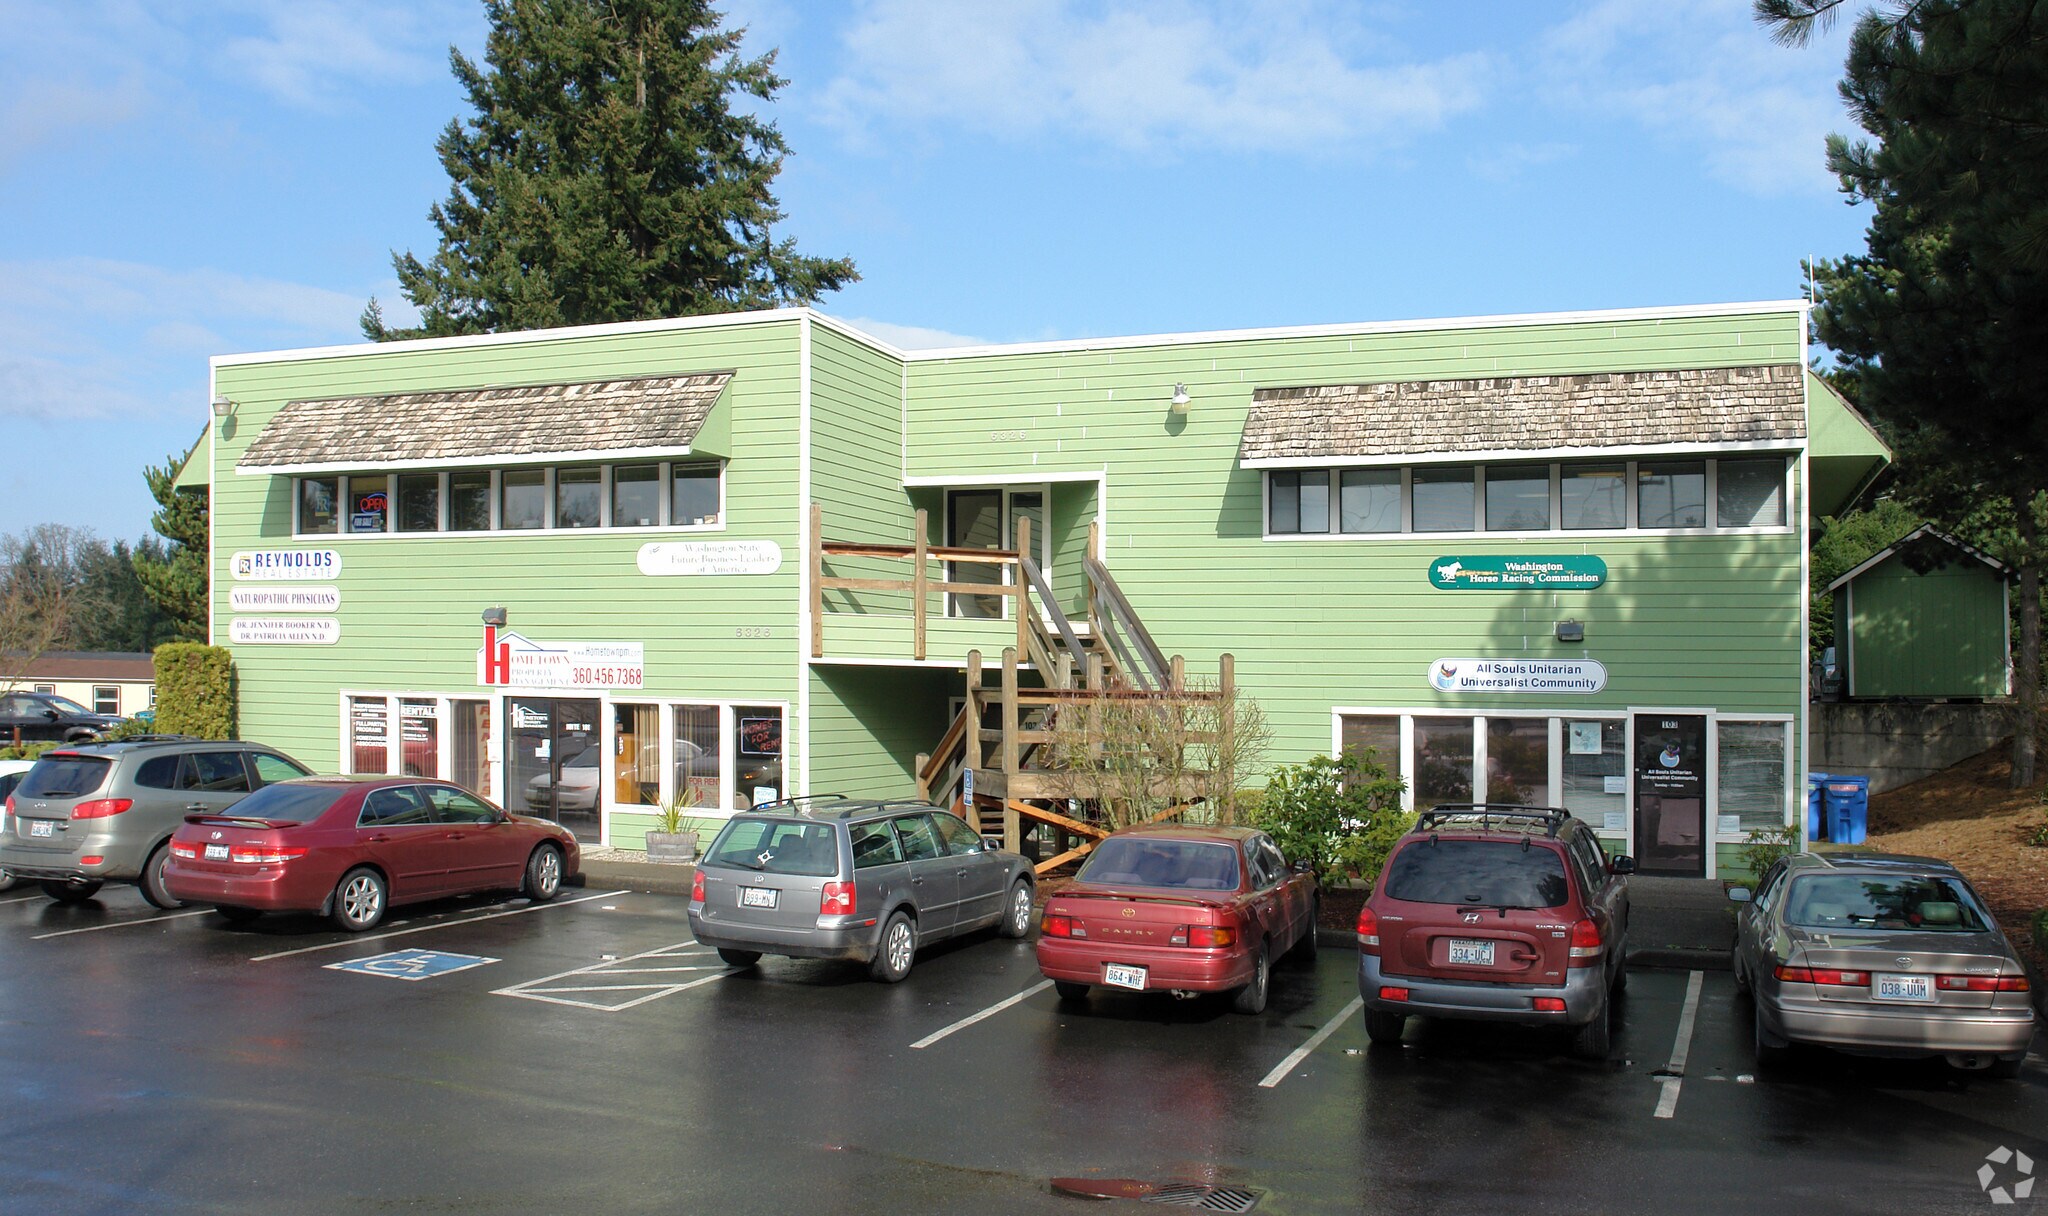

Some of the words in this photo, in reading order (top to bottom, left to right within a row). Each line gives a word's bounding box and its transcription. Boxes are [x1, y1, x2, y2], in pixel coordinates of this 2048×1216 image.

[360, 498, 386, 510] OPEN
[684, 543, 736, 553] Washington
[739, 543, 761, 552] State
[255, 552, 332, 567] REYNOLDS
[671, 554, 699, 564] Future
[701, 554, 738, 563] Business
[740, 553, 775, 563] Leaders
[255, 568, 282, 578] REAL
[288, 567, 332, 577] ESTATE
[713, 565, 748, 573] America
[1505, 562, 1564, 572] Washington
[1469, 574, 1498, 583] Horse
[1501, 574, 1534, 584] Racing
[1538, 573, 1599, 582] Commission
[234, 593, 290, 604] NATUROPATHIC
[291, 593, 336, 605] PHYSICIANS
[250, 621, 284, 629] JENNIFER
[285, 621, 315, 629] BOOKER
[253, 632, 286, 640] PATRICIA
[289, 632, 310, 640] ALLEN
[511, 668, 552, 677] PROPERTY
[1477, 664, 1491, 673] All
[1494, 664, 1526, 674] Souls
[1529, 664, 1582, 674] Unitarian
[573, 667, 642, 684] 360.456.7368
[1460, 677, 1528, 687] Universalist
[1531, 678, 1597, 690] Community
[744, 720, 773, 734] HOMES
[1662, 721, 1679, 729] 103
[752, 731, 769, 743] FOR
[688, 777, 702, 786] FOR
[1102, 927, 1154, 936] CAMRY
[1452, 948, 1492, 961] 334-UCJ
[1108, 969, 1143, 986] 864-WHF
[1881, 982, 1927, 997] 038-UUM
